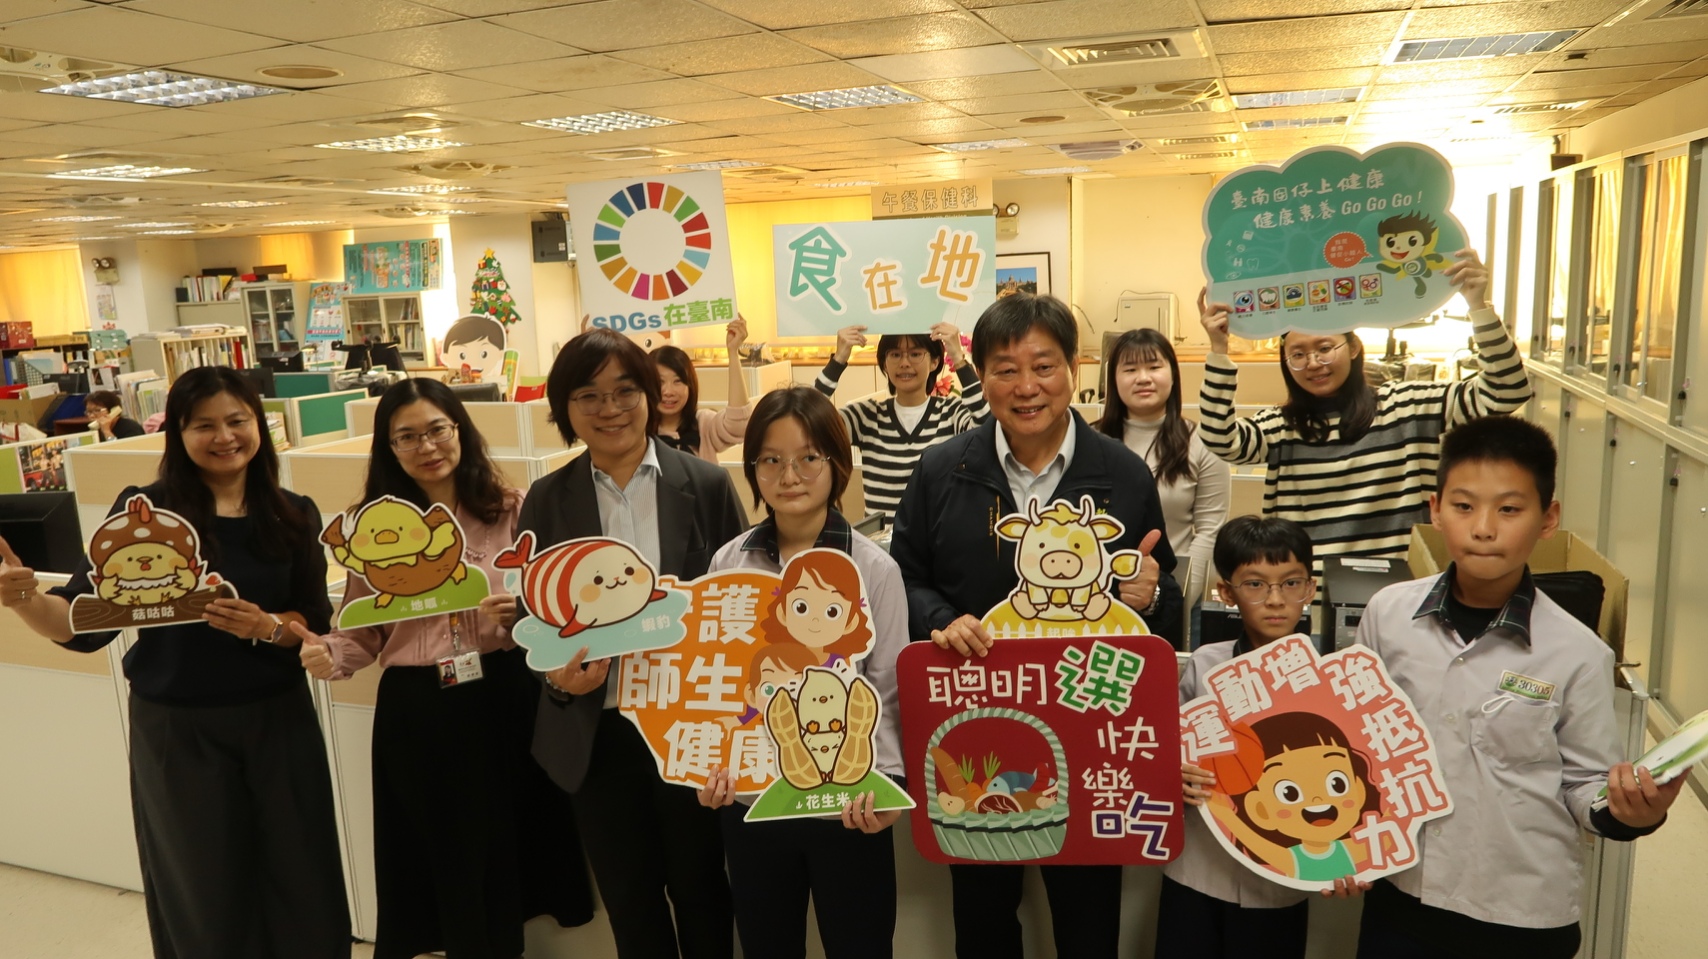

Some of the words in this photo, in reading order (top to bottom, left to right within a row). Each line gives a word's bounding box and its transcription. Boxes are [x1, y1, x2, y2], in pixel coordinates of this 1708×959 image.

[882, 185, 978, 214] 午餐保健科
[1253, 199, 1336, 229] 健康素養
[1341, 201, 1361, 215] Go
[1366, 197, 1387, 212] Go
[1392, 193, 1412, 208] Go
[788, 226, 981, 311] 食在地
[132, 605, 175, 621] 菇咕咕
[620, 651, 744, 712] 師生
[927, 640, 1146, 717] 聰明選
[1518, 679, 1551, 695] 30305
[662, 719, 780, 784] 健康
[805, 791, 851, 810] 花生米
